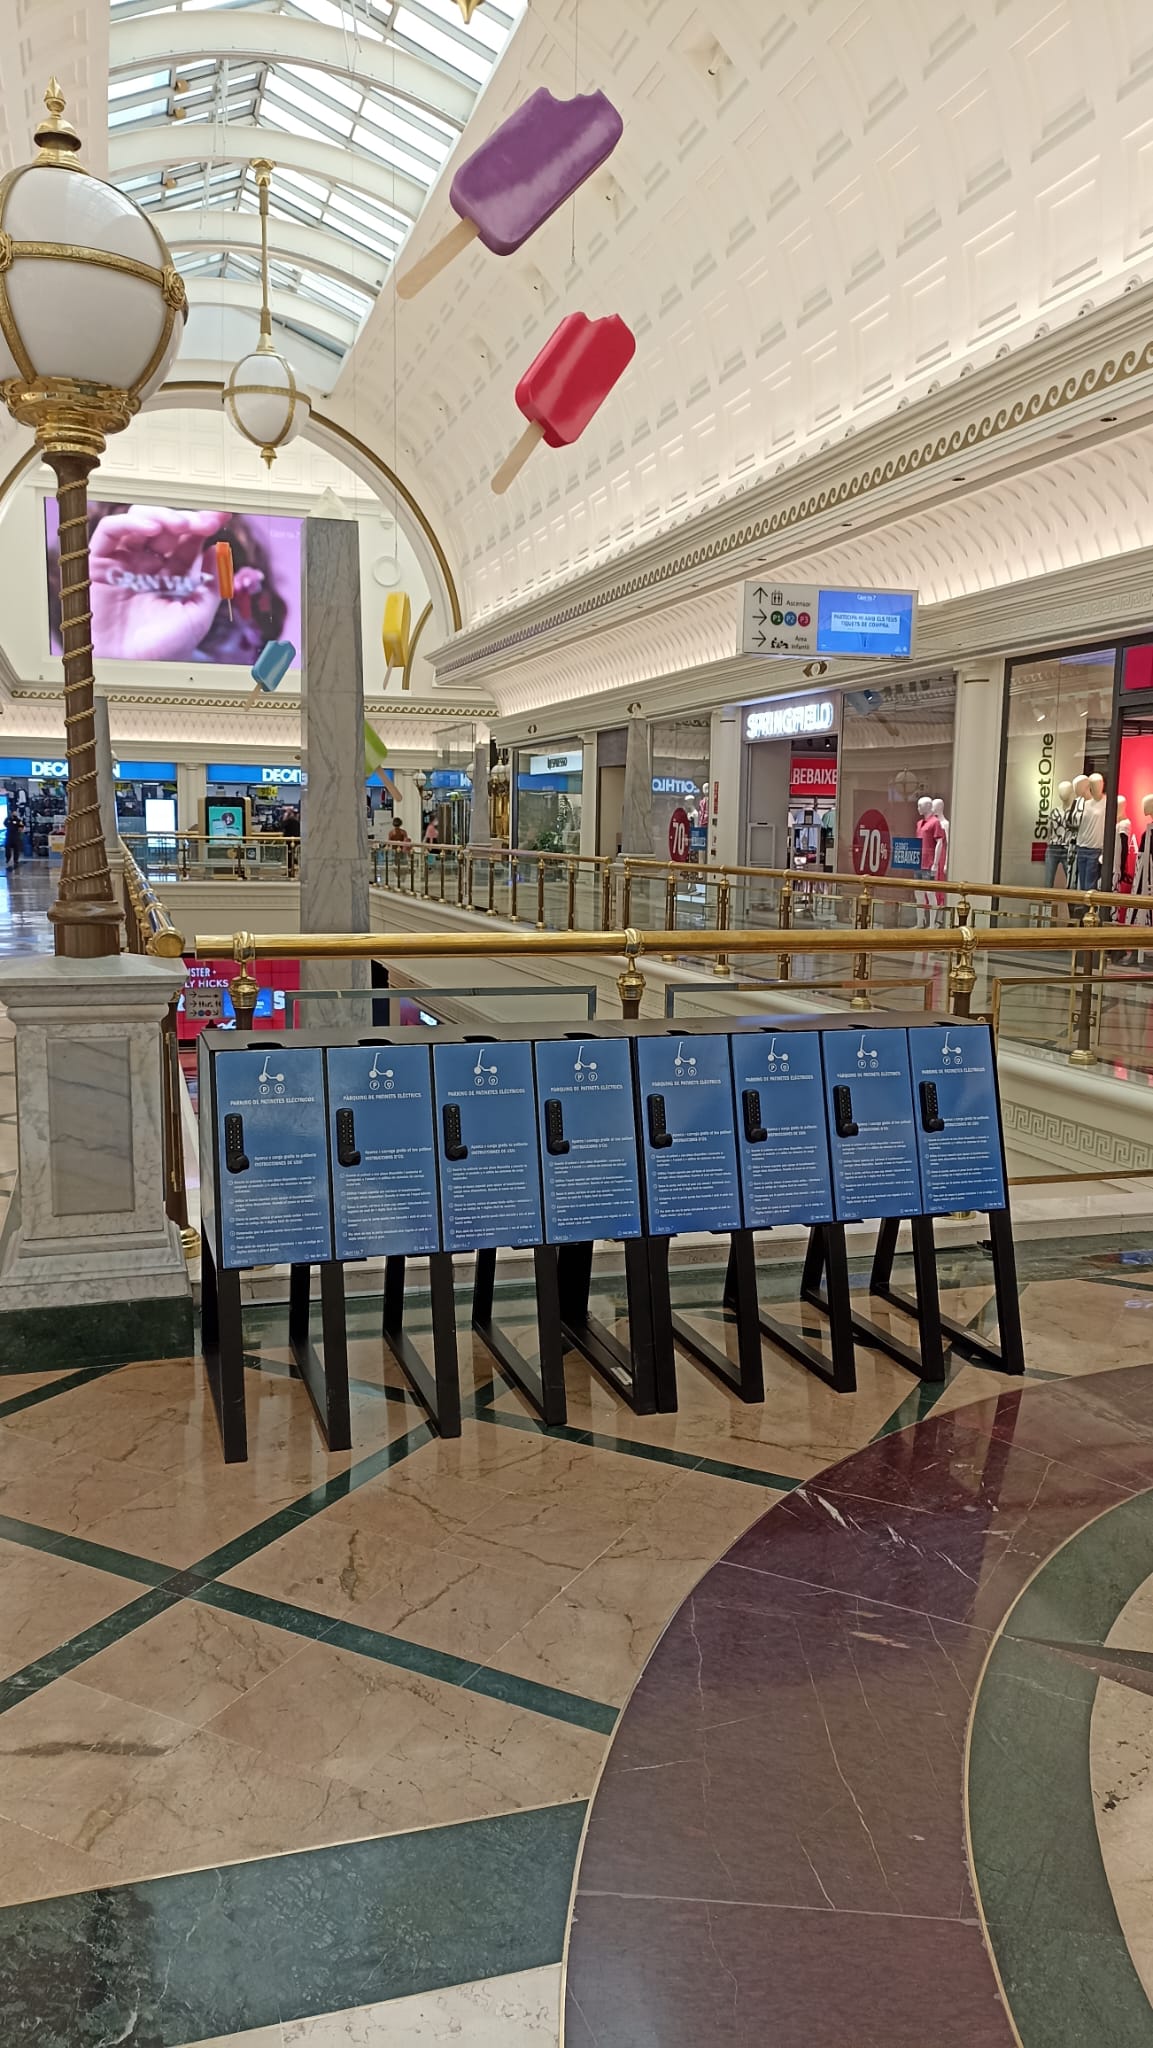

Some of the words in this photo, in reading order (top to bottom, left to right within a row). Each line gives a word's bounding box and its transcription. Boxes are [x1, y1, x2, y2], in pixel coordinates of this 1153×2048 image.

[746, 702, 834, 739] SPRINGFIELD
[1038, 733, 1054, 776] One
[1034, 778, 1051, 840] Street
[198, 979, 229, 988] HICKS
